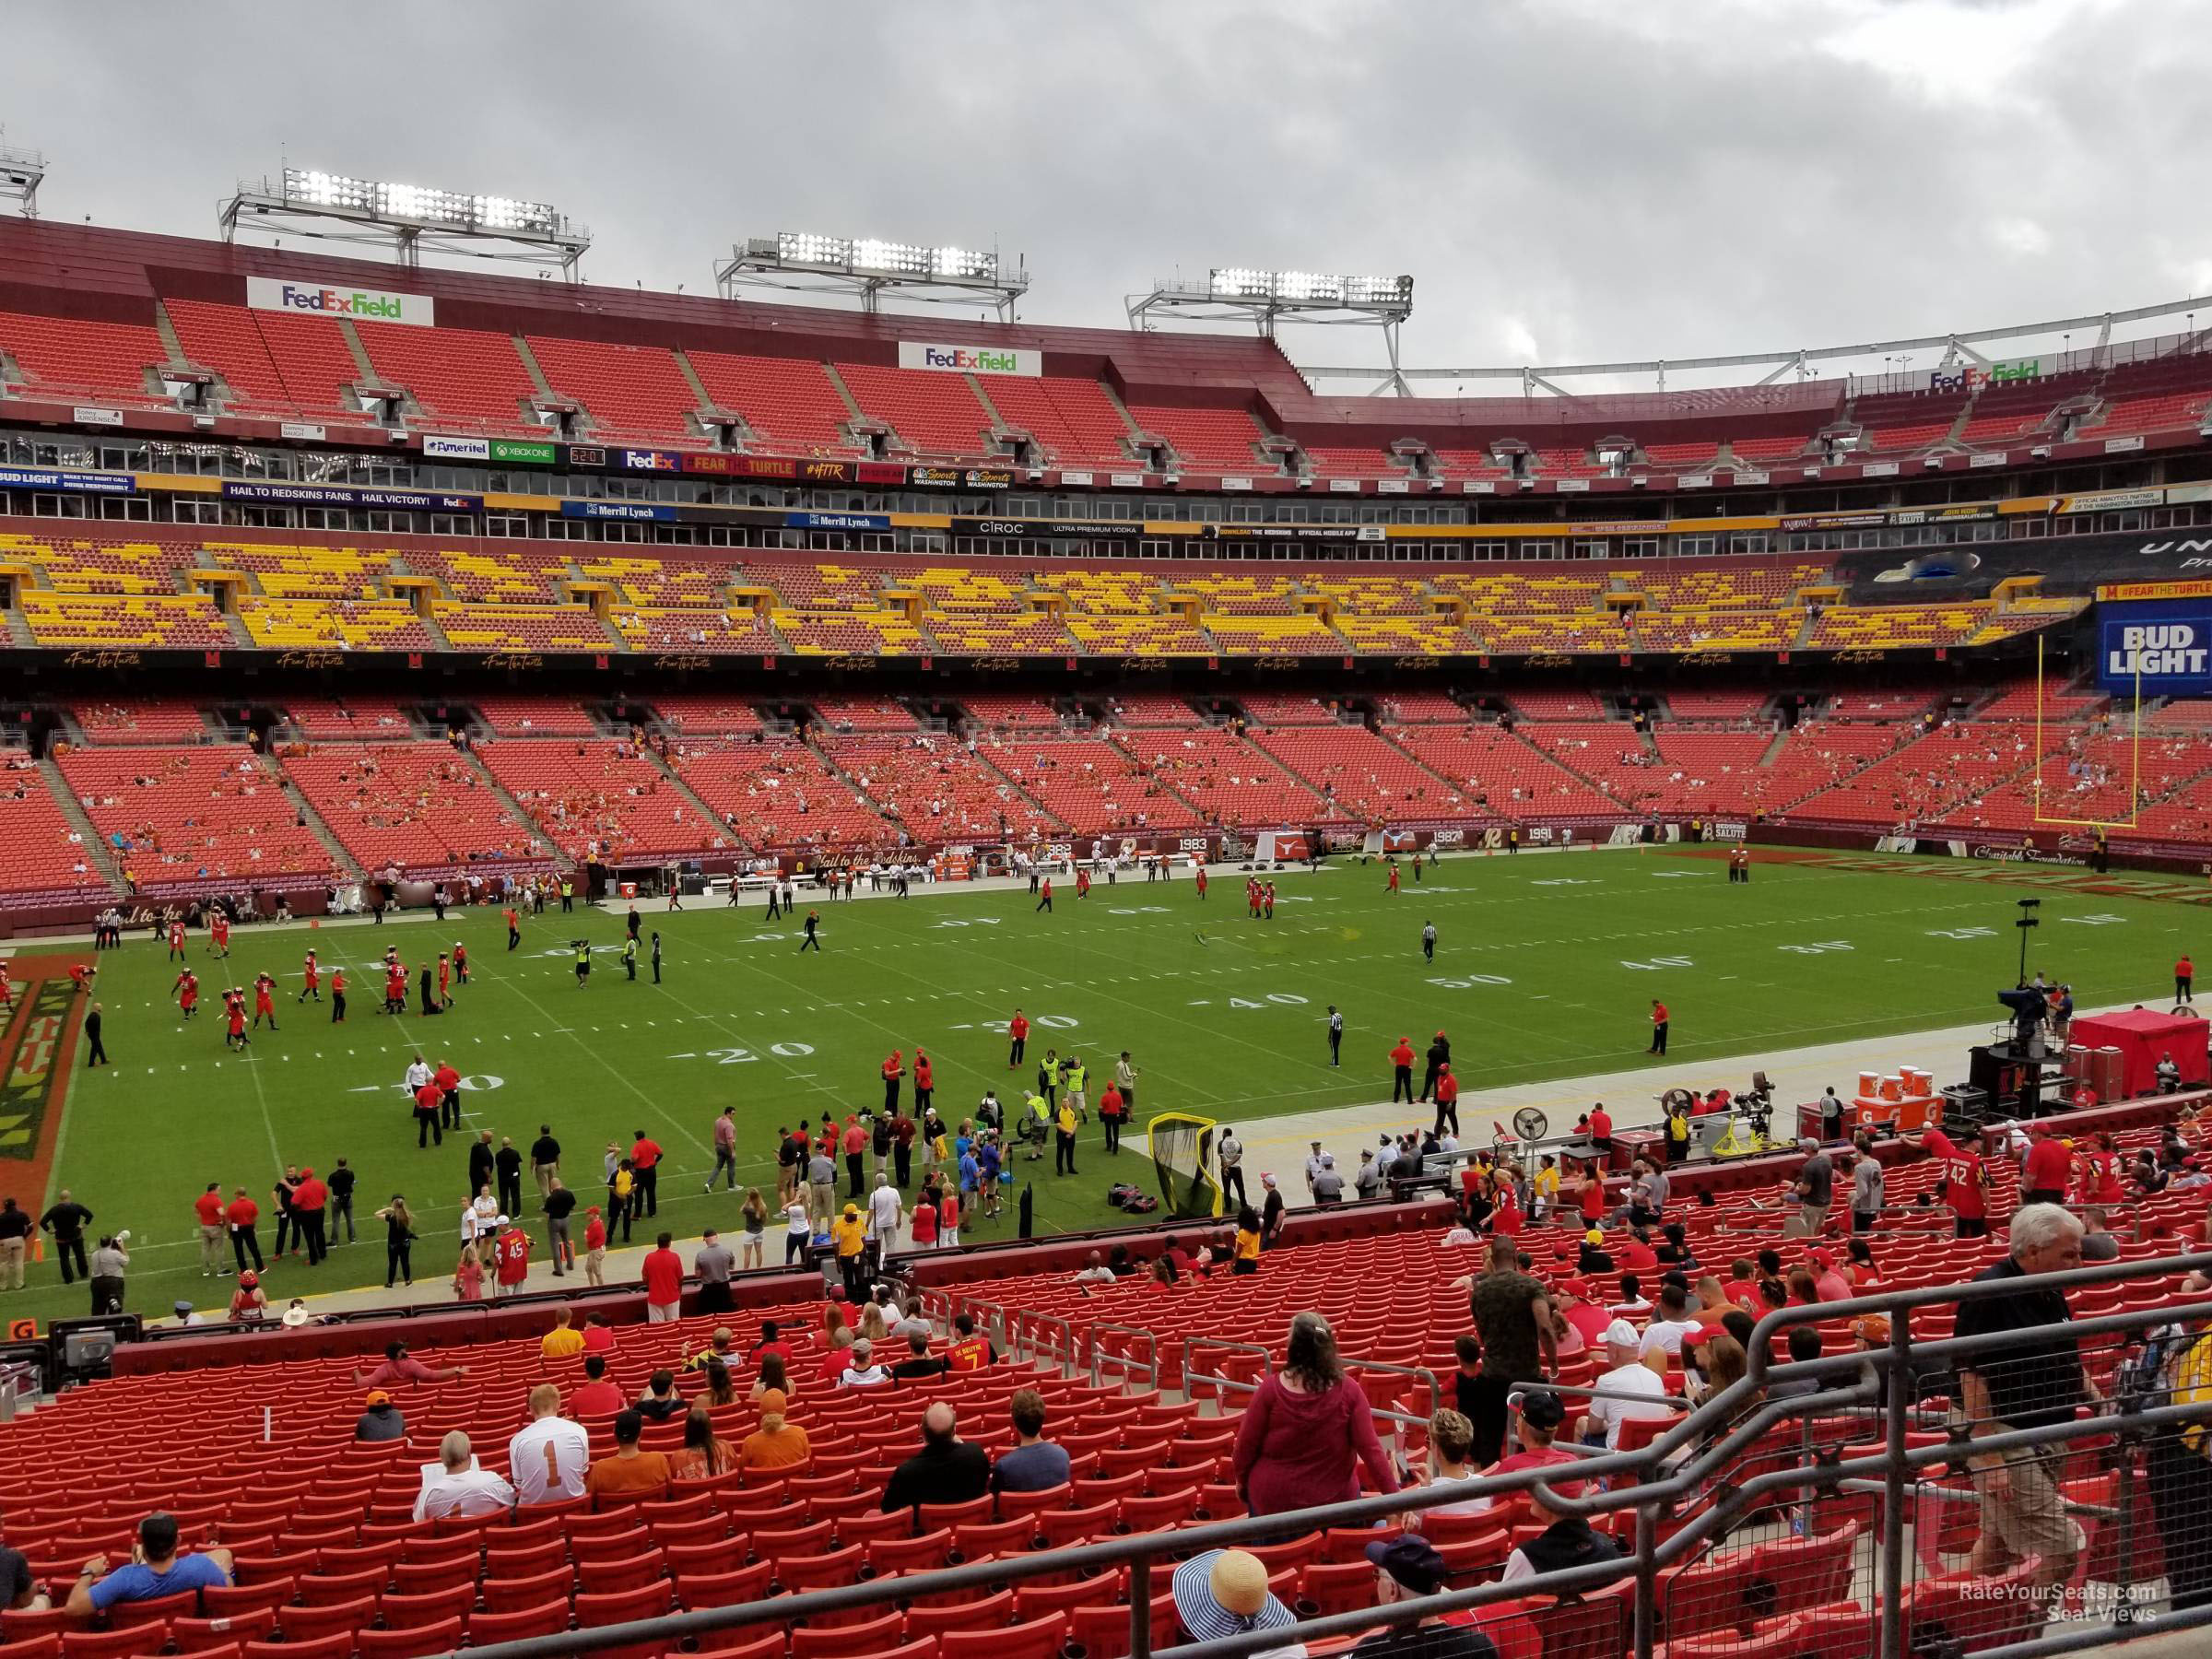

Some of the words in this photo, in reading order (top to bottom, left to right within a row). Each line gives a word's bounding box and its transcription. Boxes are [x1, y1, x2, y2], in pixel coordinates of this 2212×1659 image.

[282, 285, 402, 319] FedExField
[925, 347, 1017, 371] FedExField
[1930, 360, 2039, 388] FedExField
[437, 441, 487, 454] Ameritel
[509, 447, 532, 457] XBOX
[532, 448, 550, 458] ONE
[627, 451, 675, 470] FedEx
[694, 456, 726, 470] FEAR
[748, 461, 793, 475] TURTLE
[22, 474, 58, 485] LIGHT
[927, 468, 959, 479] Sports
[979, 472, 1011, 482] Sports
[914, 478, 956, 487] WASHINGTON
[968, 480, 1008, 488] WASHINGTON
[230, 486, 253, 496] HAIL
[254, 487, 269, 497] TO
[272, 488, 323, 500] REDSKINS
[325, 490, 354, 501] FANS.
[362, 493, 385, 503] HAIL
[386, 495, 429, 506] VICTORY!
[443, 498, 469, 508] FedEx
[599, 506, 627, 517] Merrill
[629, 507, 654, 518] Lynch
[820, 515, 846, 527] Merrill
[847, 517, 870, 528] Lynch
[1898, 515, 1925, 524] SALUTE
[2106, 586, 2118, 598] M
[2123, 582, 2212, 596] #FEARTHETURTLE
[2123, 625, 2194, 650] BUD
[2109, 649, 2208, 674] LIGHT
[1434, 830, 1459, 842] 1987
[1529, 828, 1553, 840] 1991
[1715, 830, 1747, 839] SALUTE
[1179, 838, 1207, 851] 1983
[841, 853, 853, 865] to
[853, 852, 870, 865] the
[2026, 849, 2086, 865] Foundation
[626, 886, 634, 895] G
[395, 969, 405, 977] 73
[1862, 1110, 1873, 1124] G
[1950, 1165, 1968, 1187] 42
[510, 1241, 524, 1259] 45
[12, 1320, 34, 1341] G
[964, 1352, 978, 1371] 7
[544, 1438, 562, 1488] 1
